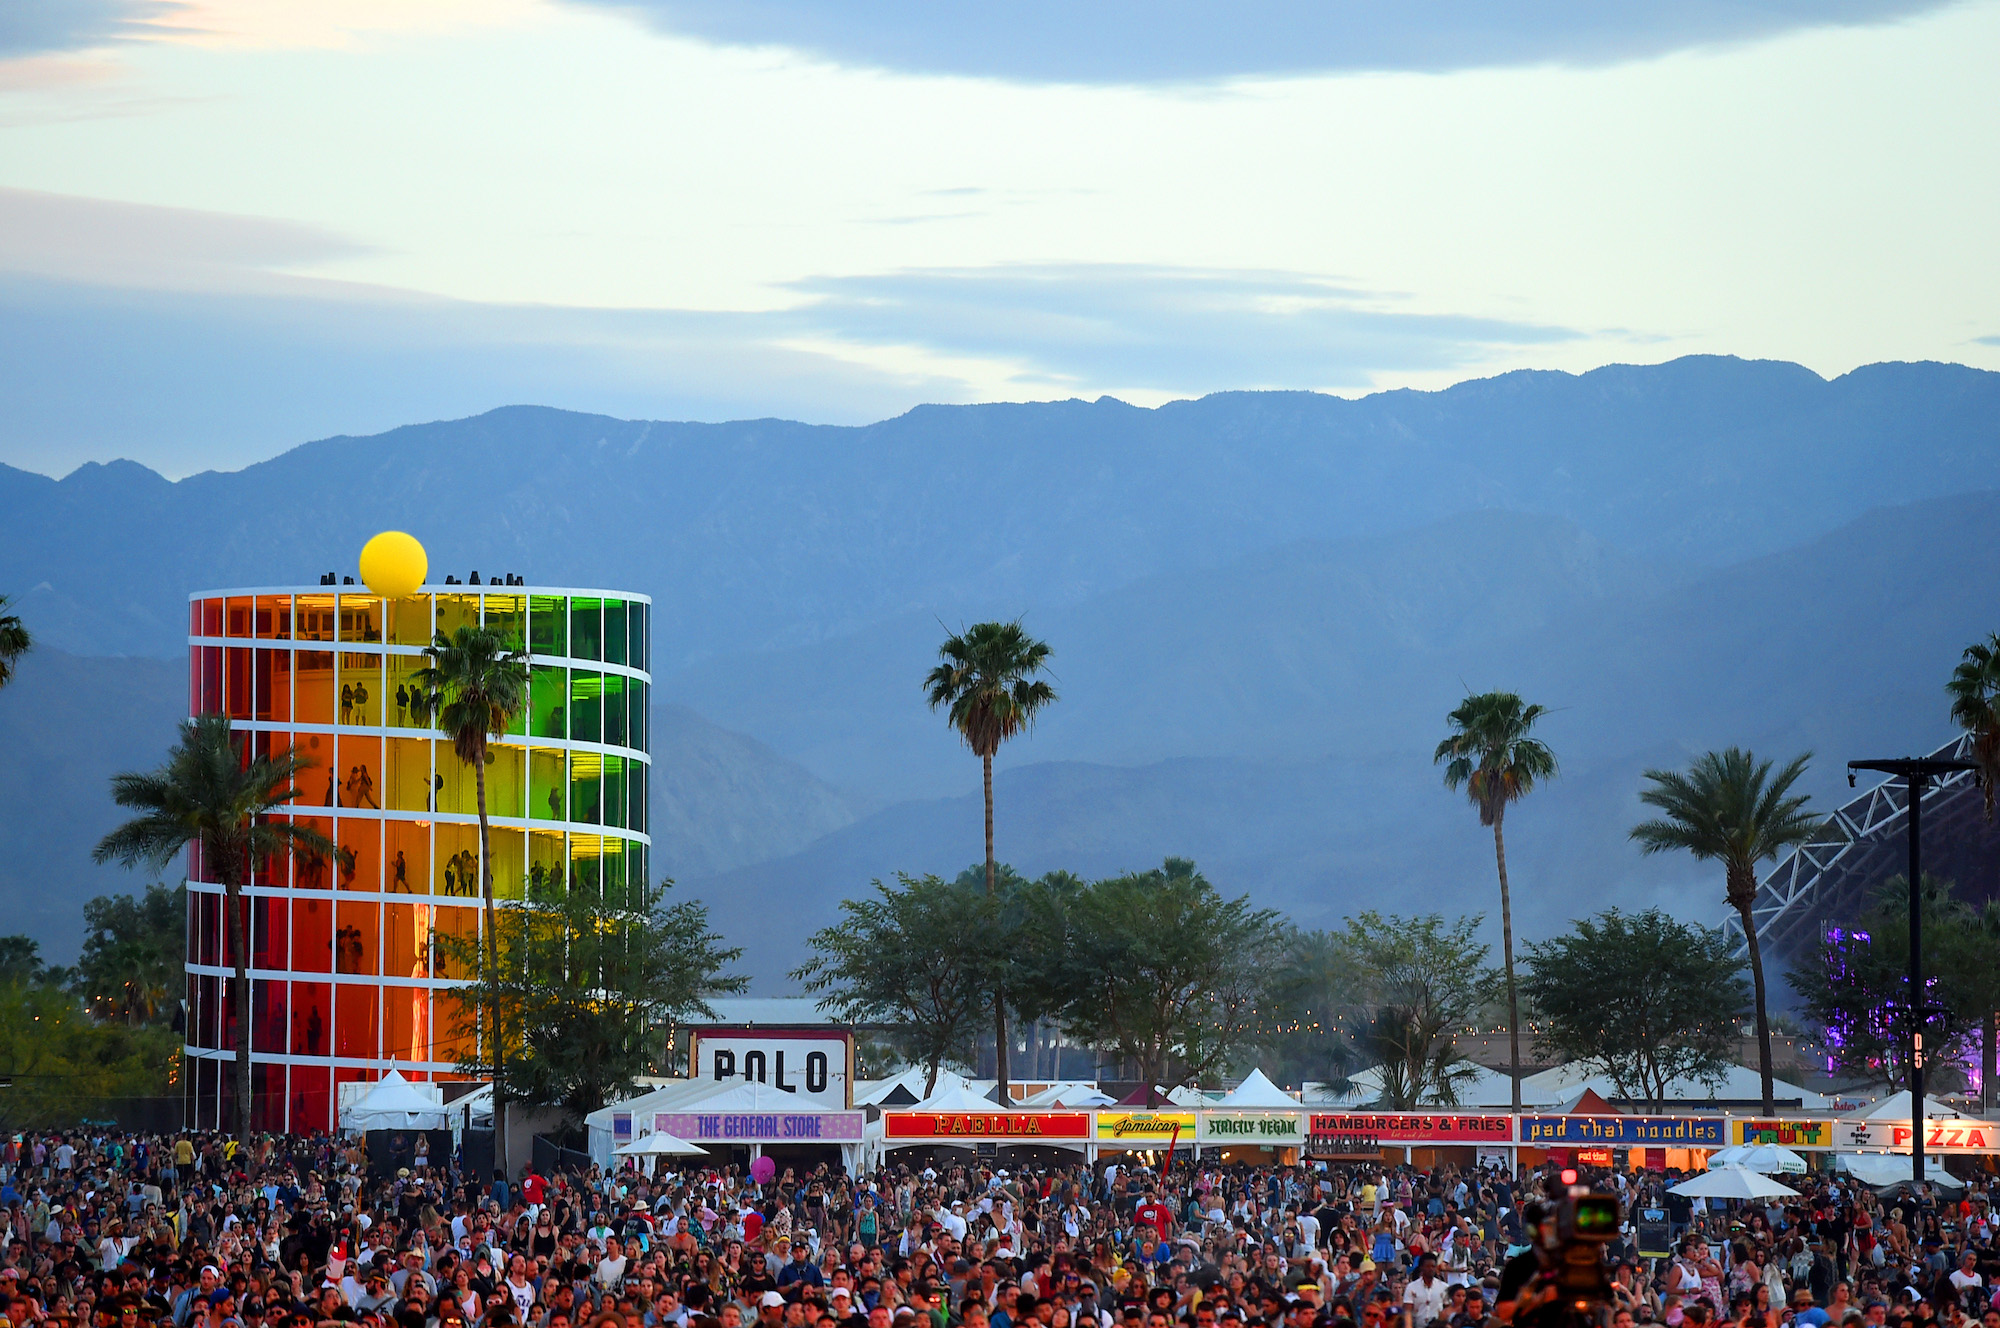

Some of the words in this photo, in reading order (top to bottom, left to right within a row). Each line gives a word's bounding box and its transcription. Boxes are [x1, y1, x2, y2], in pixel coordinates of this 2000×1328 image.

[714, 1049, 828, 1094] POLO
[697, 1116, 720, 1137] THE
[724, 1116, 780, 1137] GENERAL
[784, 1116, 822, 1137] STORE
[934, 1116, 1042, 1135] PAELLA
[1114, 1118, 1179, 1137] Jamaican
[1208, 1118, 1256, 1135] STRICTLY
[1258, 1119, 1297, 1136] VEGAN
[1315, 1117, 1433, 1130] HAMBURGERS
[1438, 1118, 1452, 1131] &
[1459, 1118, 1506, 1131] FRIES
[1530, 1120, 1567, 1142] pad
[1636, 1120, 1717, 1139] noodles
[1744, 1130, 1822, 1145] FRUIT
[1893, 1127, 1986, 1147] PZZA
